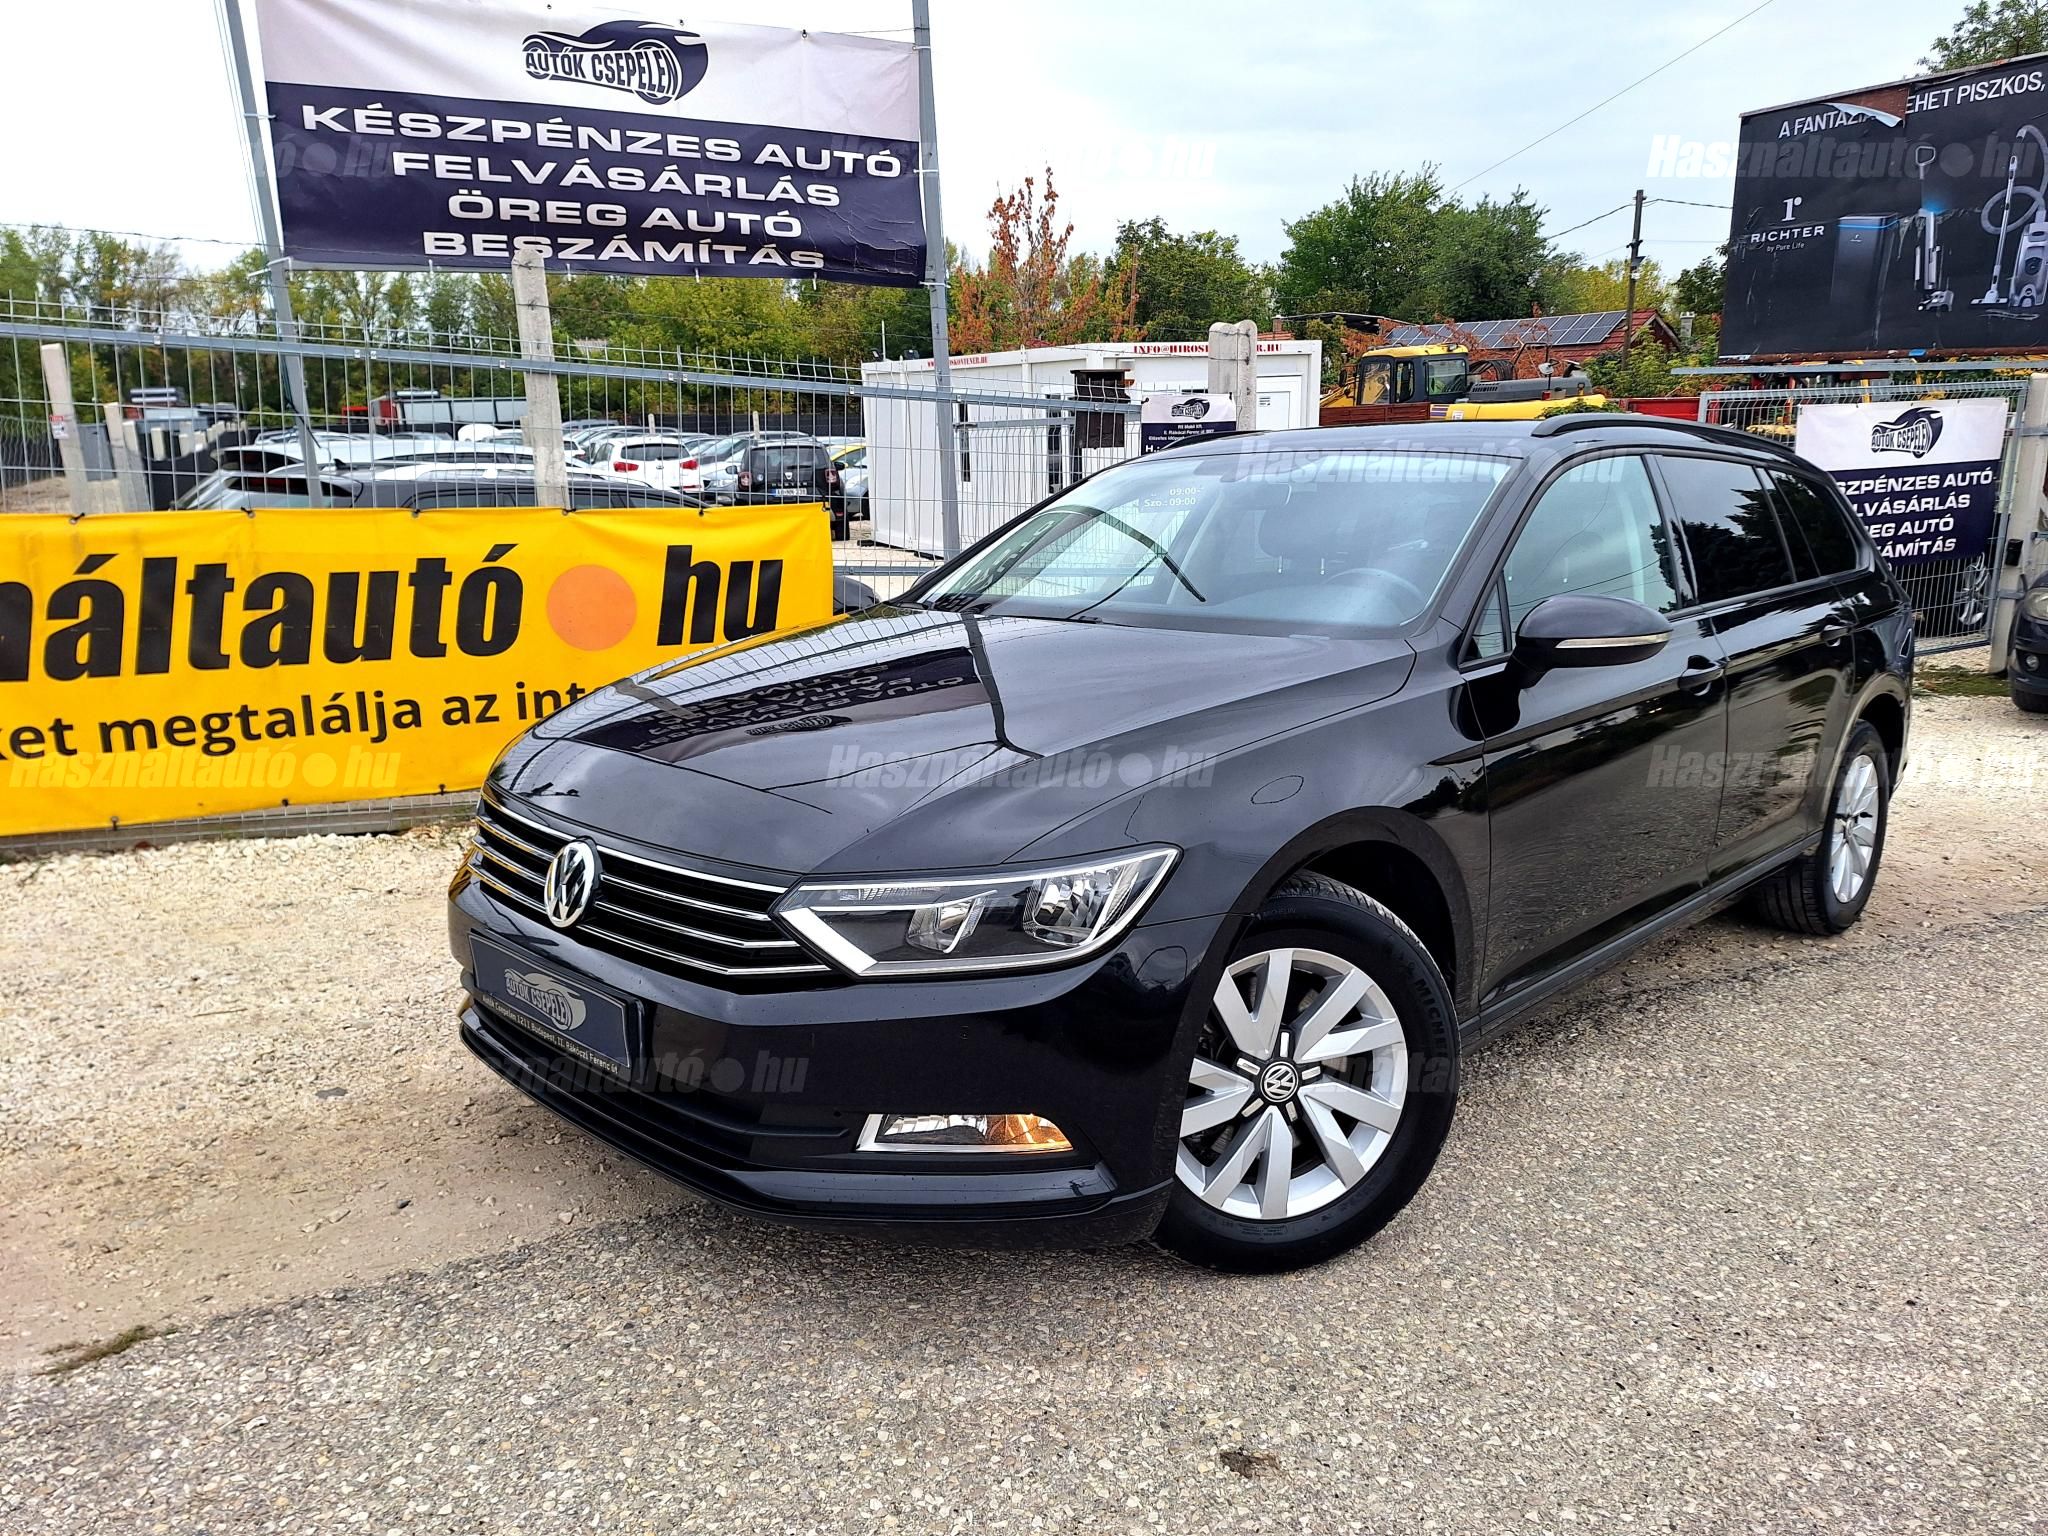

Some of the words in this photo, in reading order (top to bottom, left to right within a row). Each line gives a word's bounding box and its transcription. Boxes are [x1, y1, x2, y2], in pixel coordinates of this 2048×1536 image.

[591, 49, 679, 97] CSEPELEN
[1957, 71, 2046, 105] PISZKOS,
[302, 103, 744, 162] KÉSZPÉNZES
[753, 142, 902, 179] AUTÓ
[1778, 120, 1791, 138] A
[392, 151, 839, 207] FELVÁSÁRLÁS
[448, 188, 626, 228] ÖREG
[640, 206, 802, 239] AUTÓ
[423, 231, 825, 270] BESZÁMÍTÁS
[1750, 225, 1825, 243] RICHTER
[1943, 466, 1993, 489] AUTÓ
[1898, 513, 1954, 536] AUTÓ
[658, 544, 784, 648] hu
[98, 690, 422, 757] megtalálja
[442, 693, 501, 726] az
[515, 681, 604, 720] int
[589, 1052, 611, 1071] Ferenc
